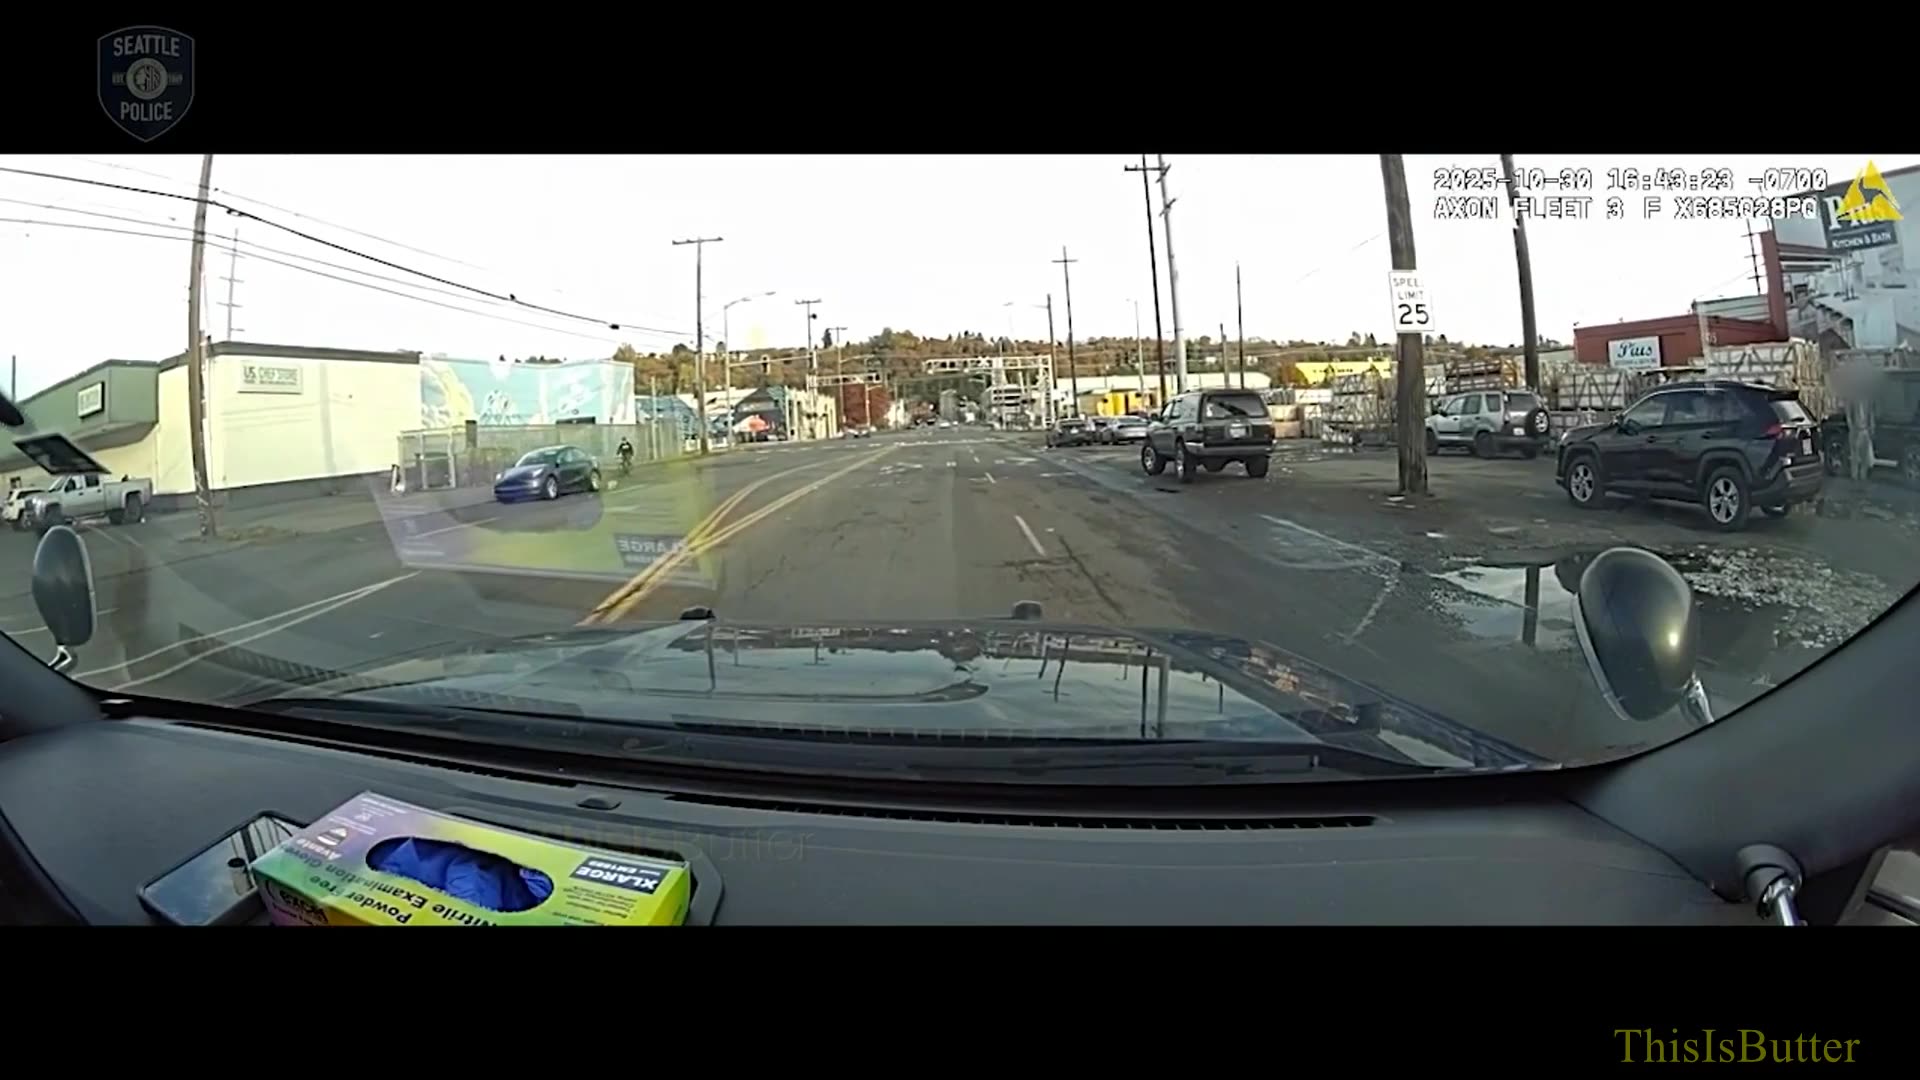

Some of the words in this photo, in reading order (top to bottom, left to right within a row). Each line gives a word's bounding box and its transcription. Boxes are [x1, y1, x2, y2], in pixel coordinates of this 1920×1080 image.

[1398, 291, 1423, 300] LIMIT
[1398, 303, 1429, 325] 25
[296, 839, 342, 860] Avante
[309, 875, 344, 897] Free
[325, 864, 428, 910] Examination
[576, 866, 658, 890] XLARGE
[345, 892, 413, 924] Powder
